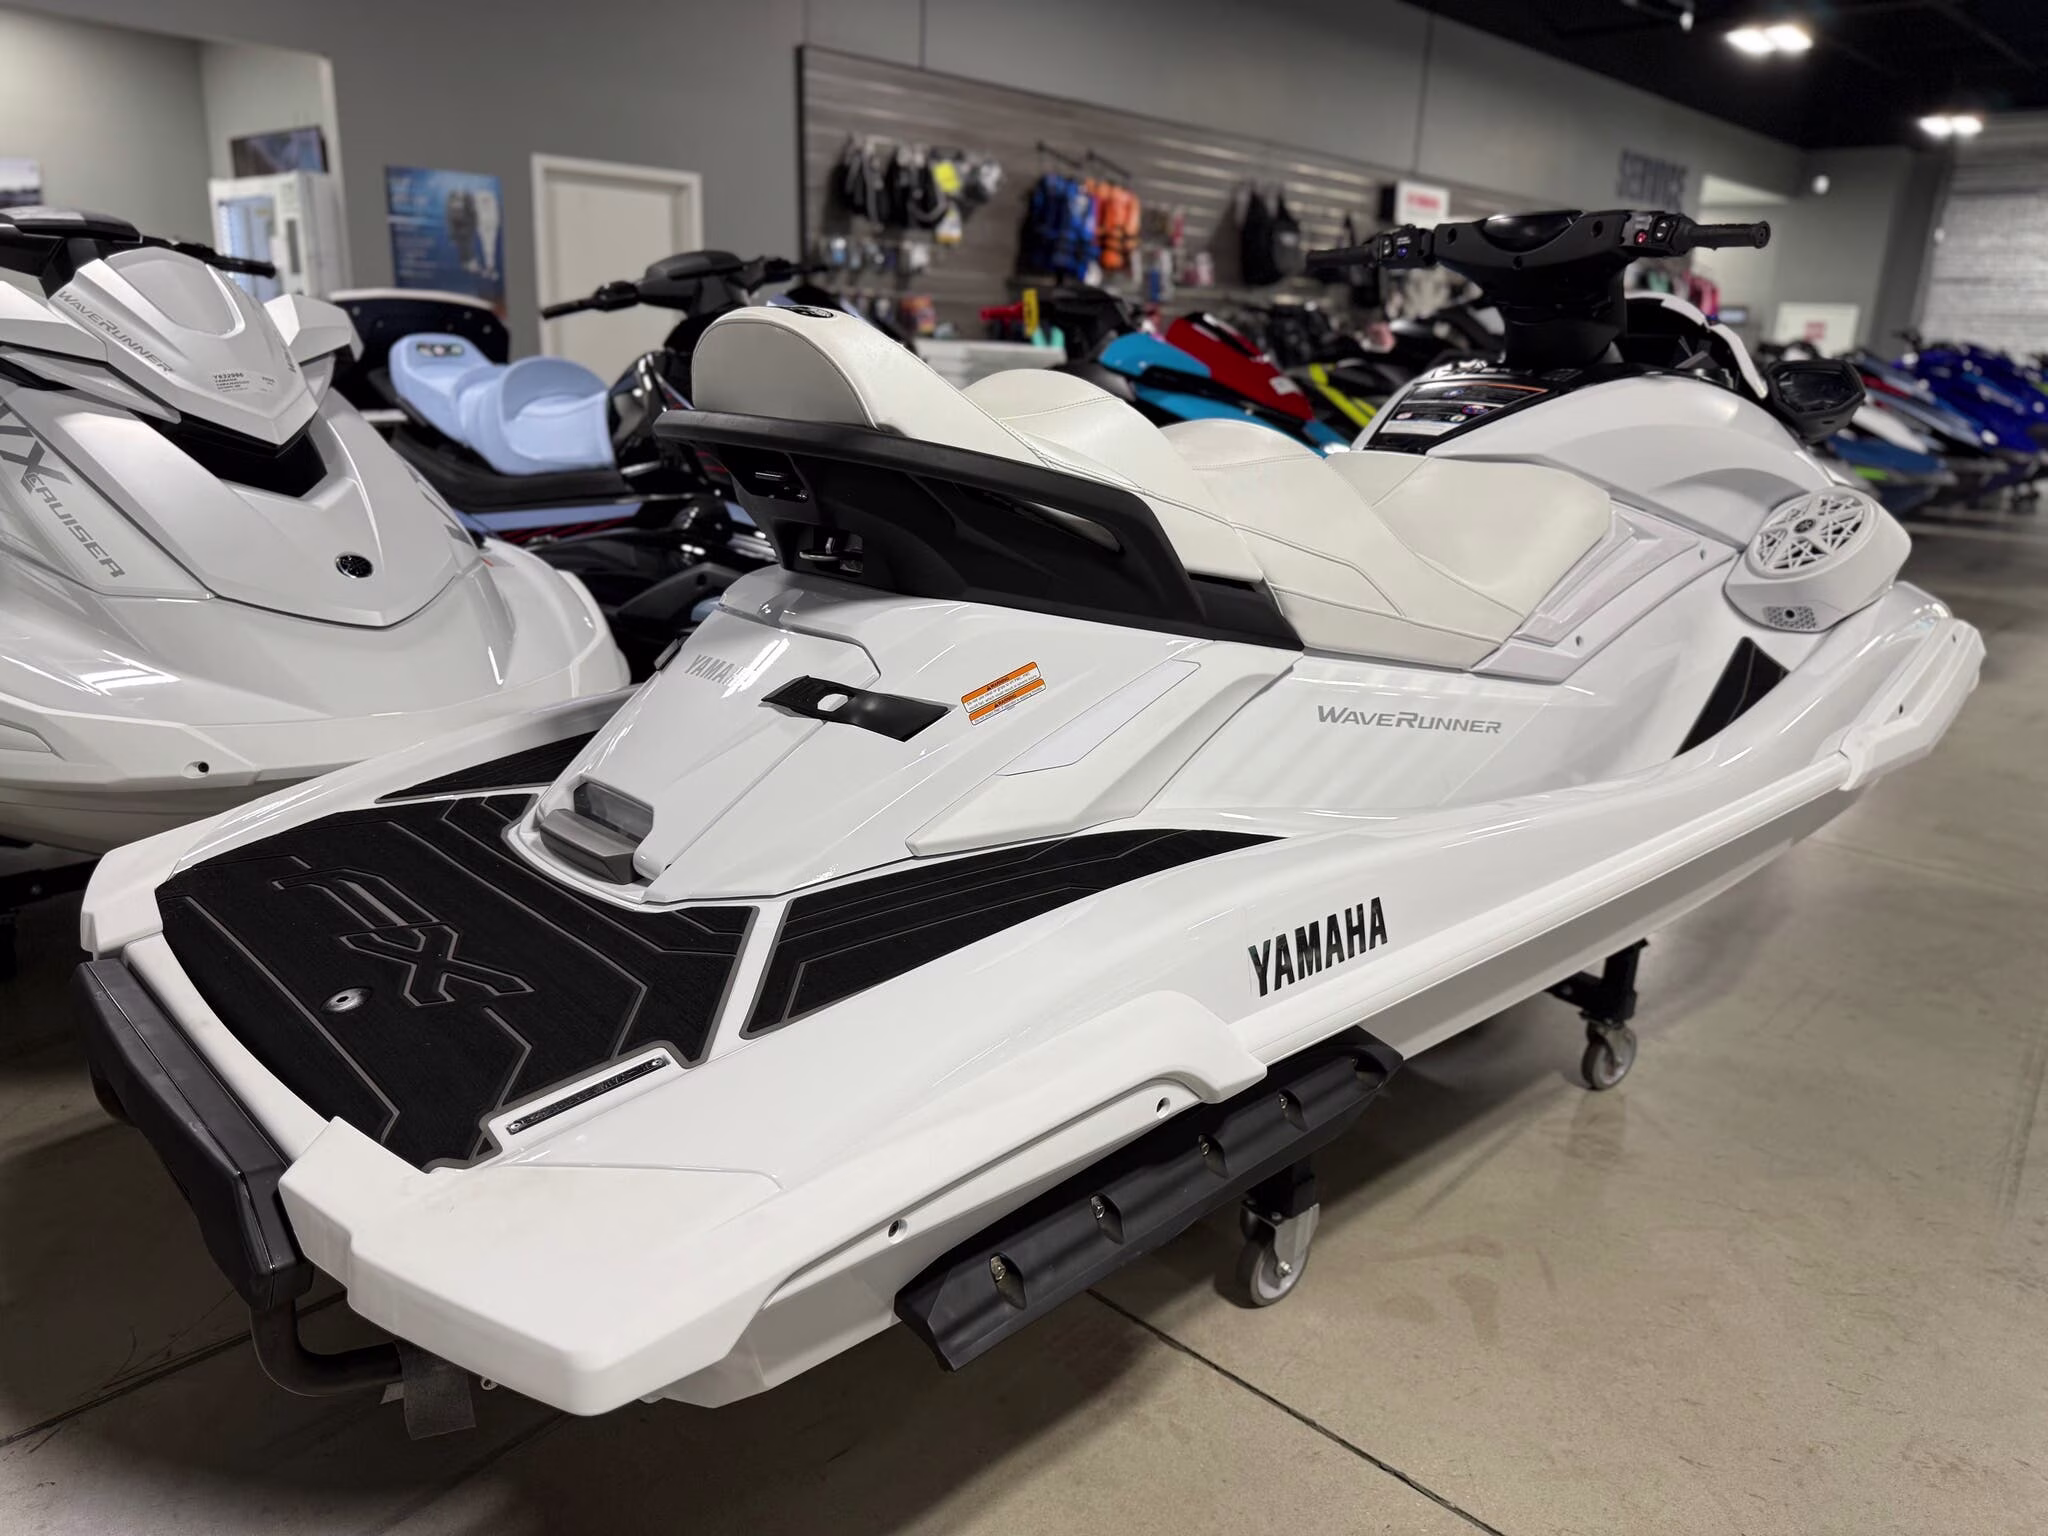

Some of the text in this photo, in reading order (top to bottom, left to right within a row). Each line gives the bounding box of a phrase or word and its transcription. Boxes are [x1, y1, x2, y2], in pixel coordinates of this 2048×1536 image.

[24, 472, 126, 578] CRUISER
[684, 654, 752, 693] YAMA
[1248, 897, 1388, 997] YAMAHA
